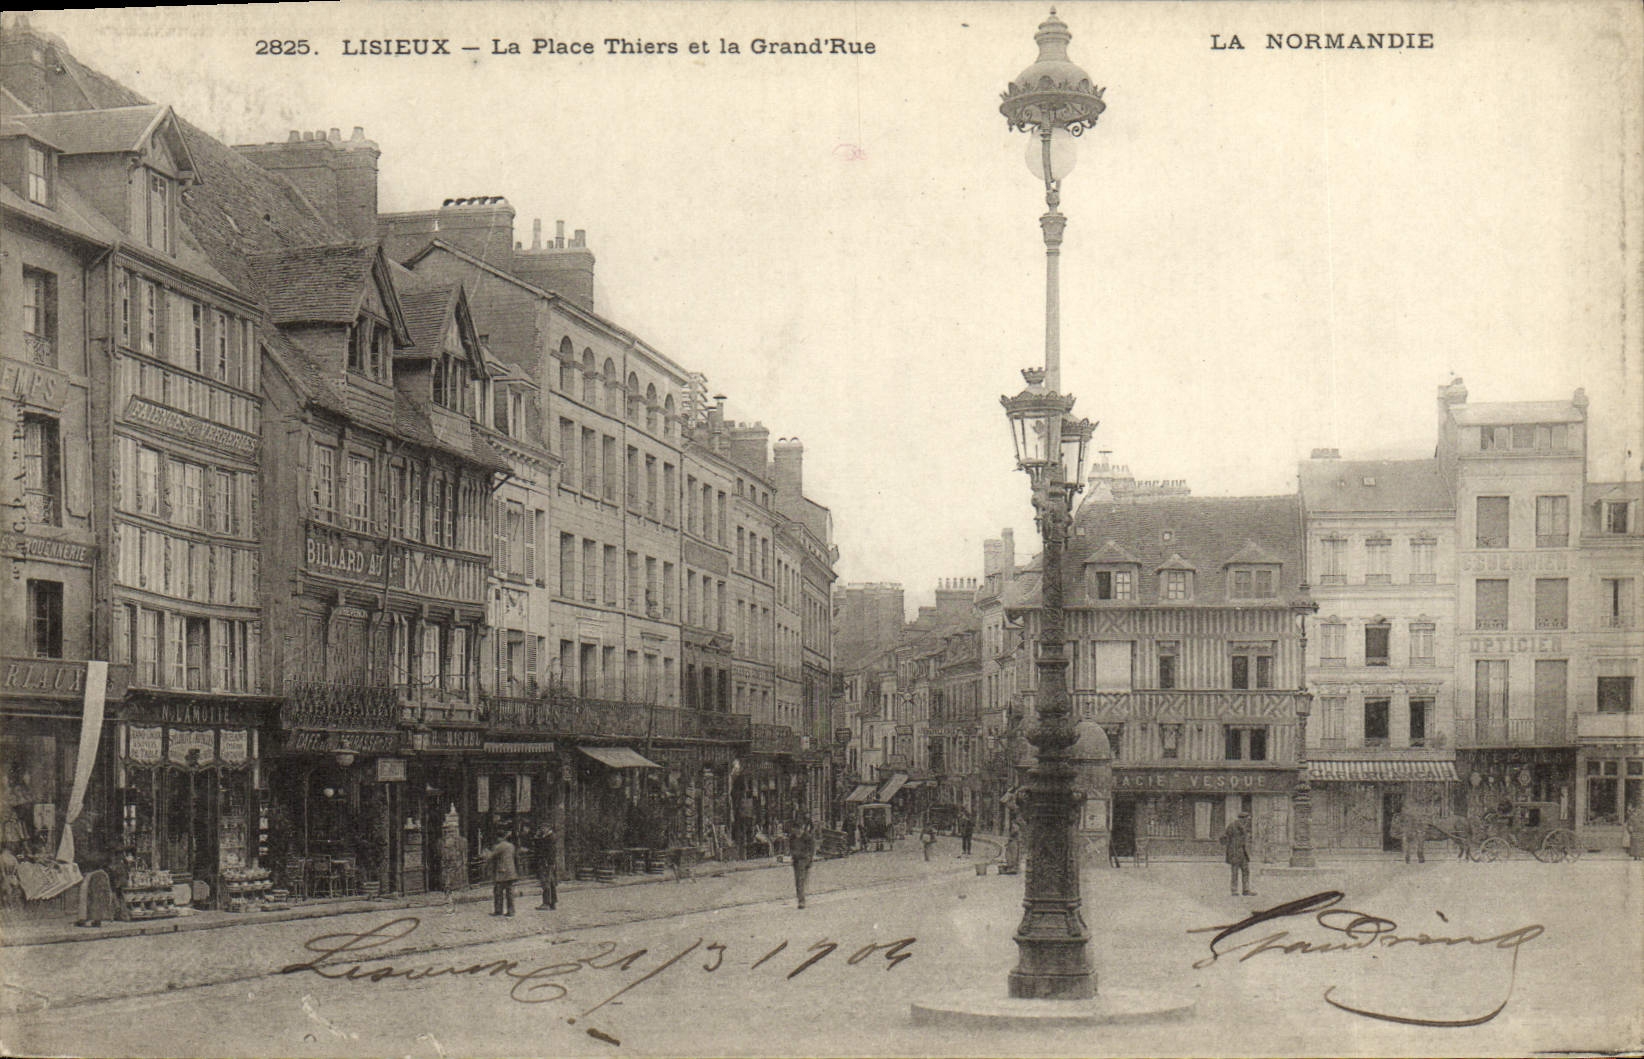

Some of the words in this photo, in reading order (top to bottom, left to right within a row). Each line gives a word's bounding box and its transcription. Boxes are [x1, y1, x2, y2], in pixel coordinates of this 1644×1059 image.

[306, 537, 365, 573] BILLARD
[367, 552, 384, 577] AU
[1469, 636, 1563, 654] OPTICIEN
[1190, 774, 1266, 788] VESQUE
